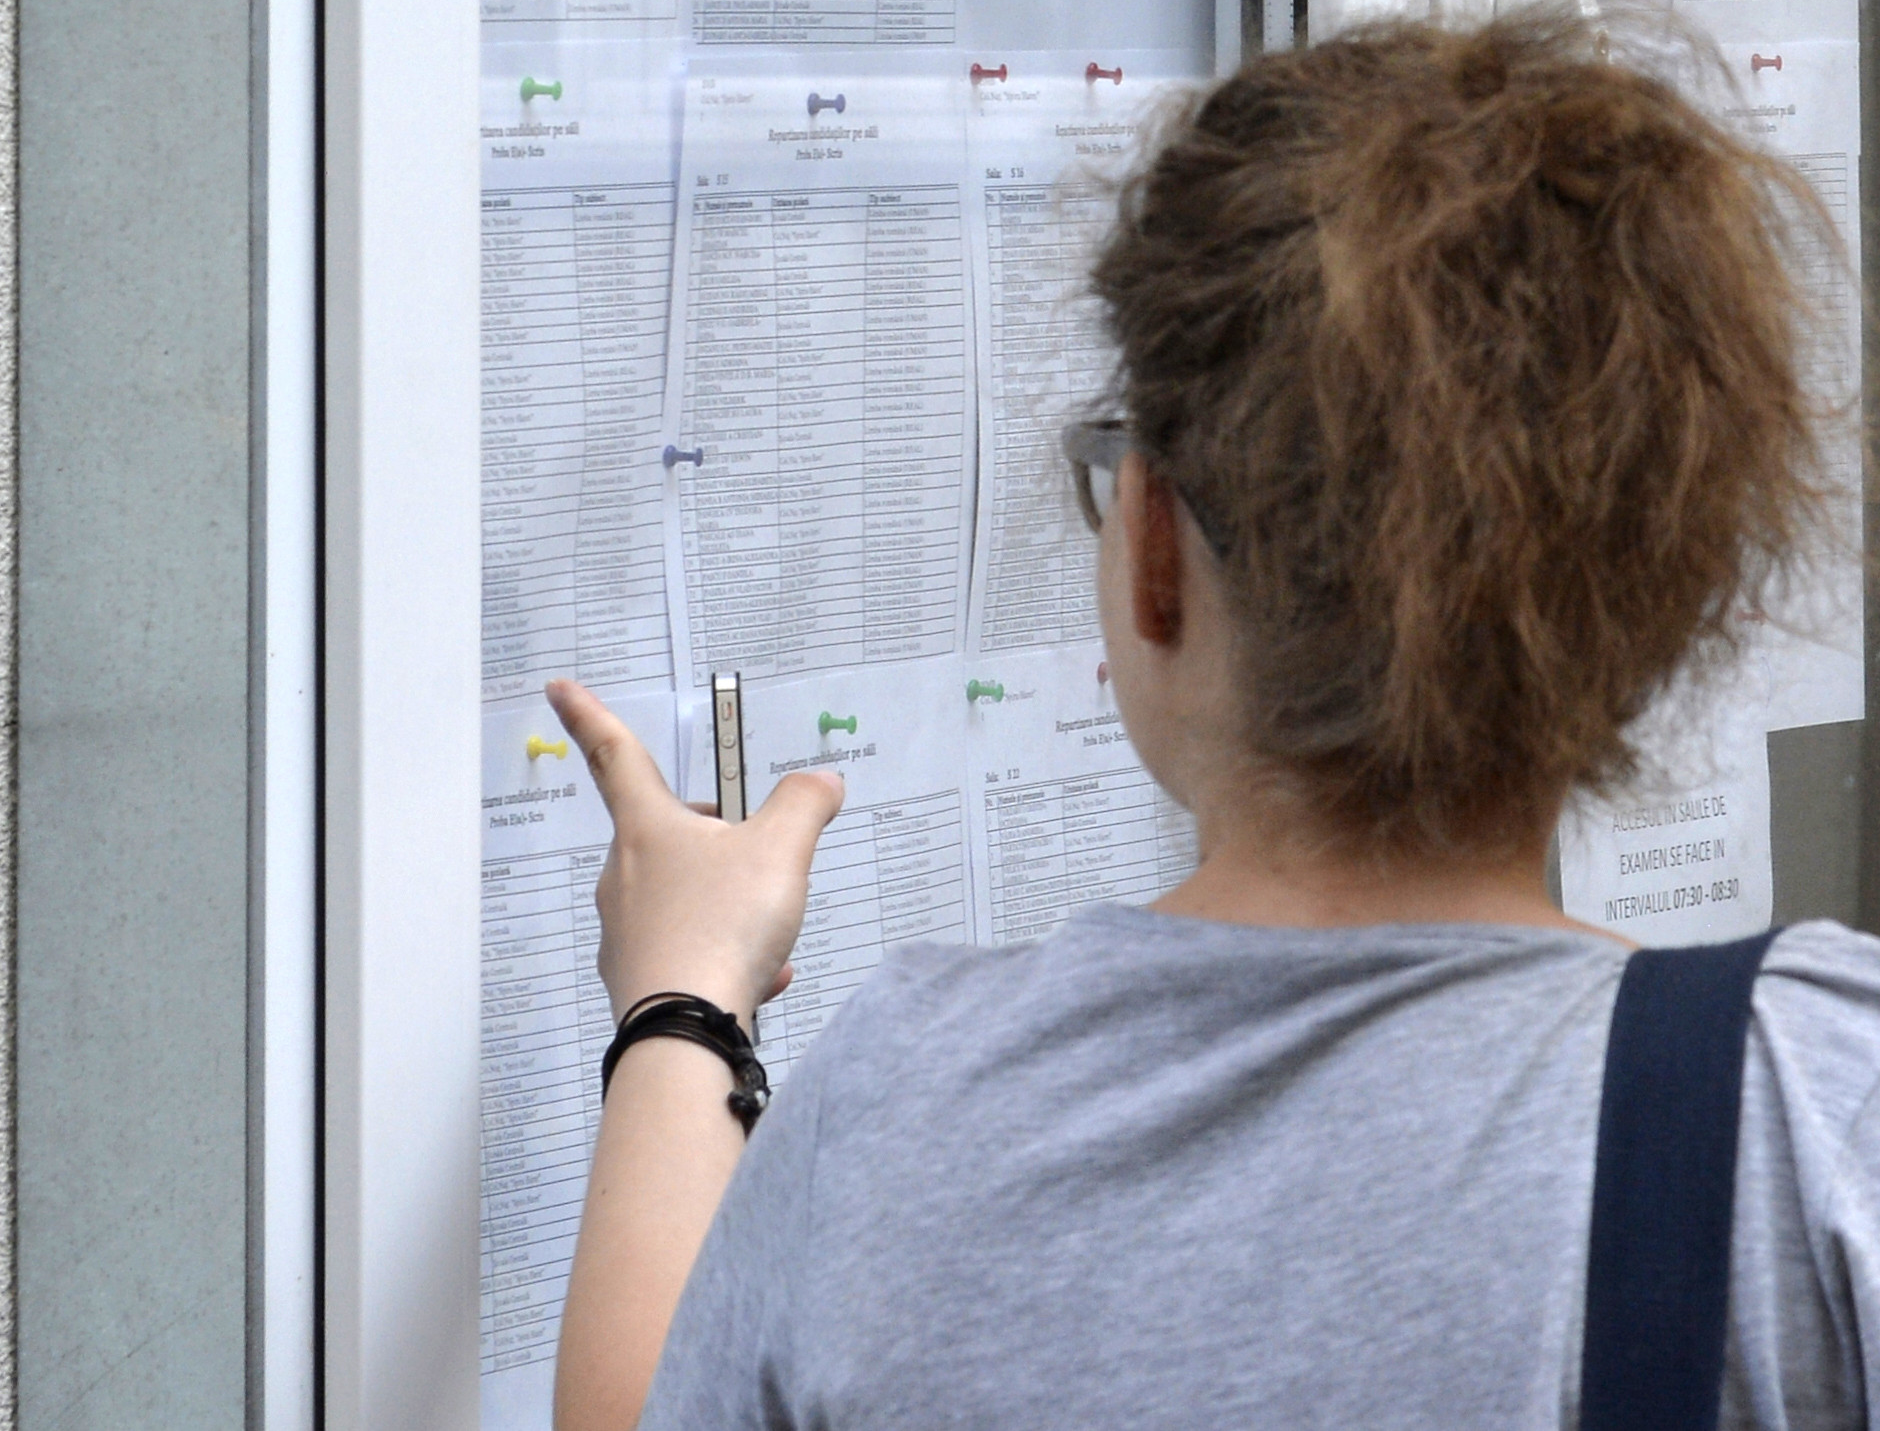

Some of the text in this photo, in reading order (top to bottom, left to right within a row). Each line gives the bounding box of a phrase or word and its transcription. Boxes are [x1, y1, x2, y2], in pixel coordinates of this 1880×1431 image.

[1711, 795, 1727, 817] DE
[1620, 838, 1725, 875] EXAMEN SE FACE IN
[1605, 891, 1672, 921] INTERVALUL
[1673, 885, 1703, 909] 07:30
[1711, 878, 1739, 902] 08:30
